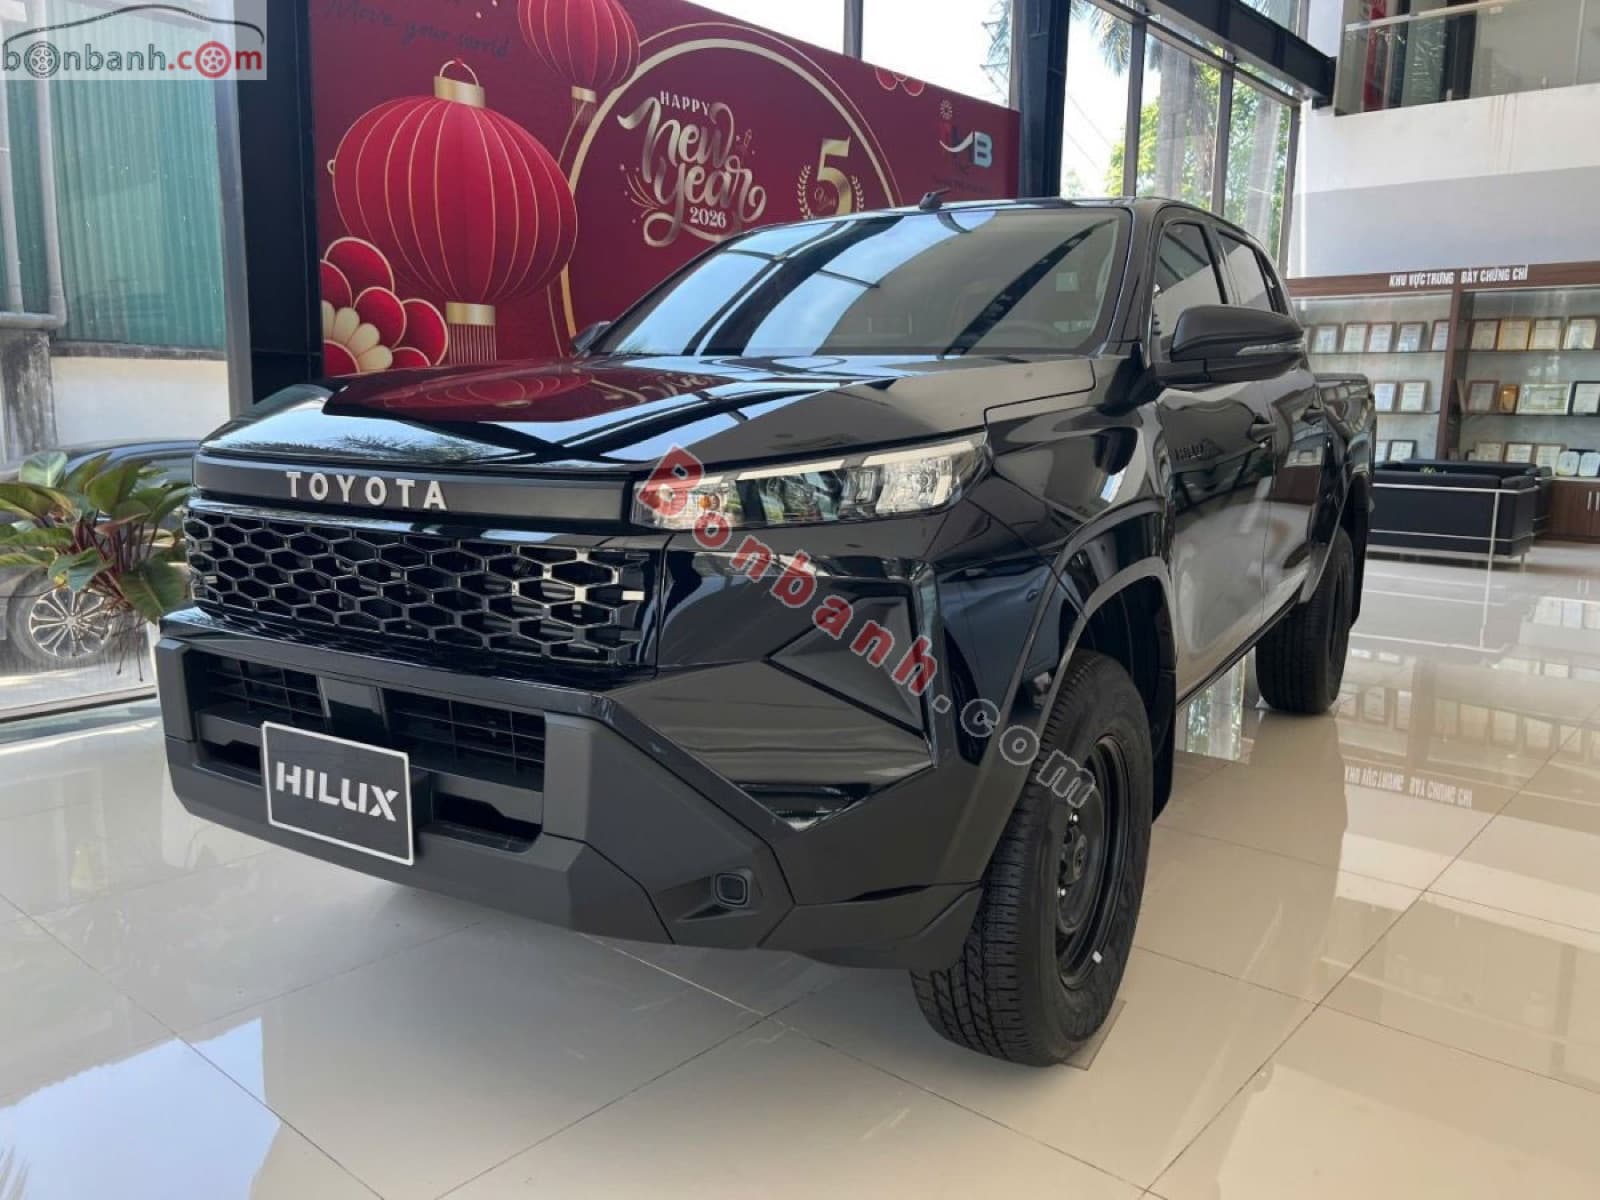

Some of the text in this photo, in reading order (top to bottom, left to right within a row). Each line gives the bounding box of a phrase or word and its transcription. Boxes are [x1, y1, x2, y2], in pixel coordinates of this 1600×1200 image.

[659, 90, 710, 116] HAPPY
[689, 206, 727, 229] 2026
[285, 471, 448, 511] TOYOTA
[275, 761, 399, 822] HILUX
